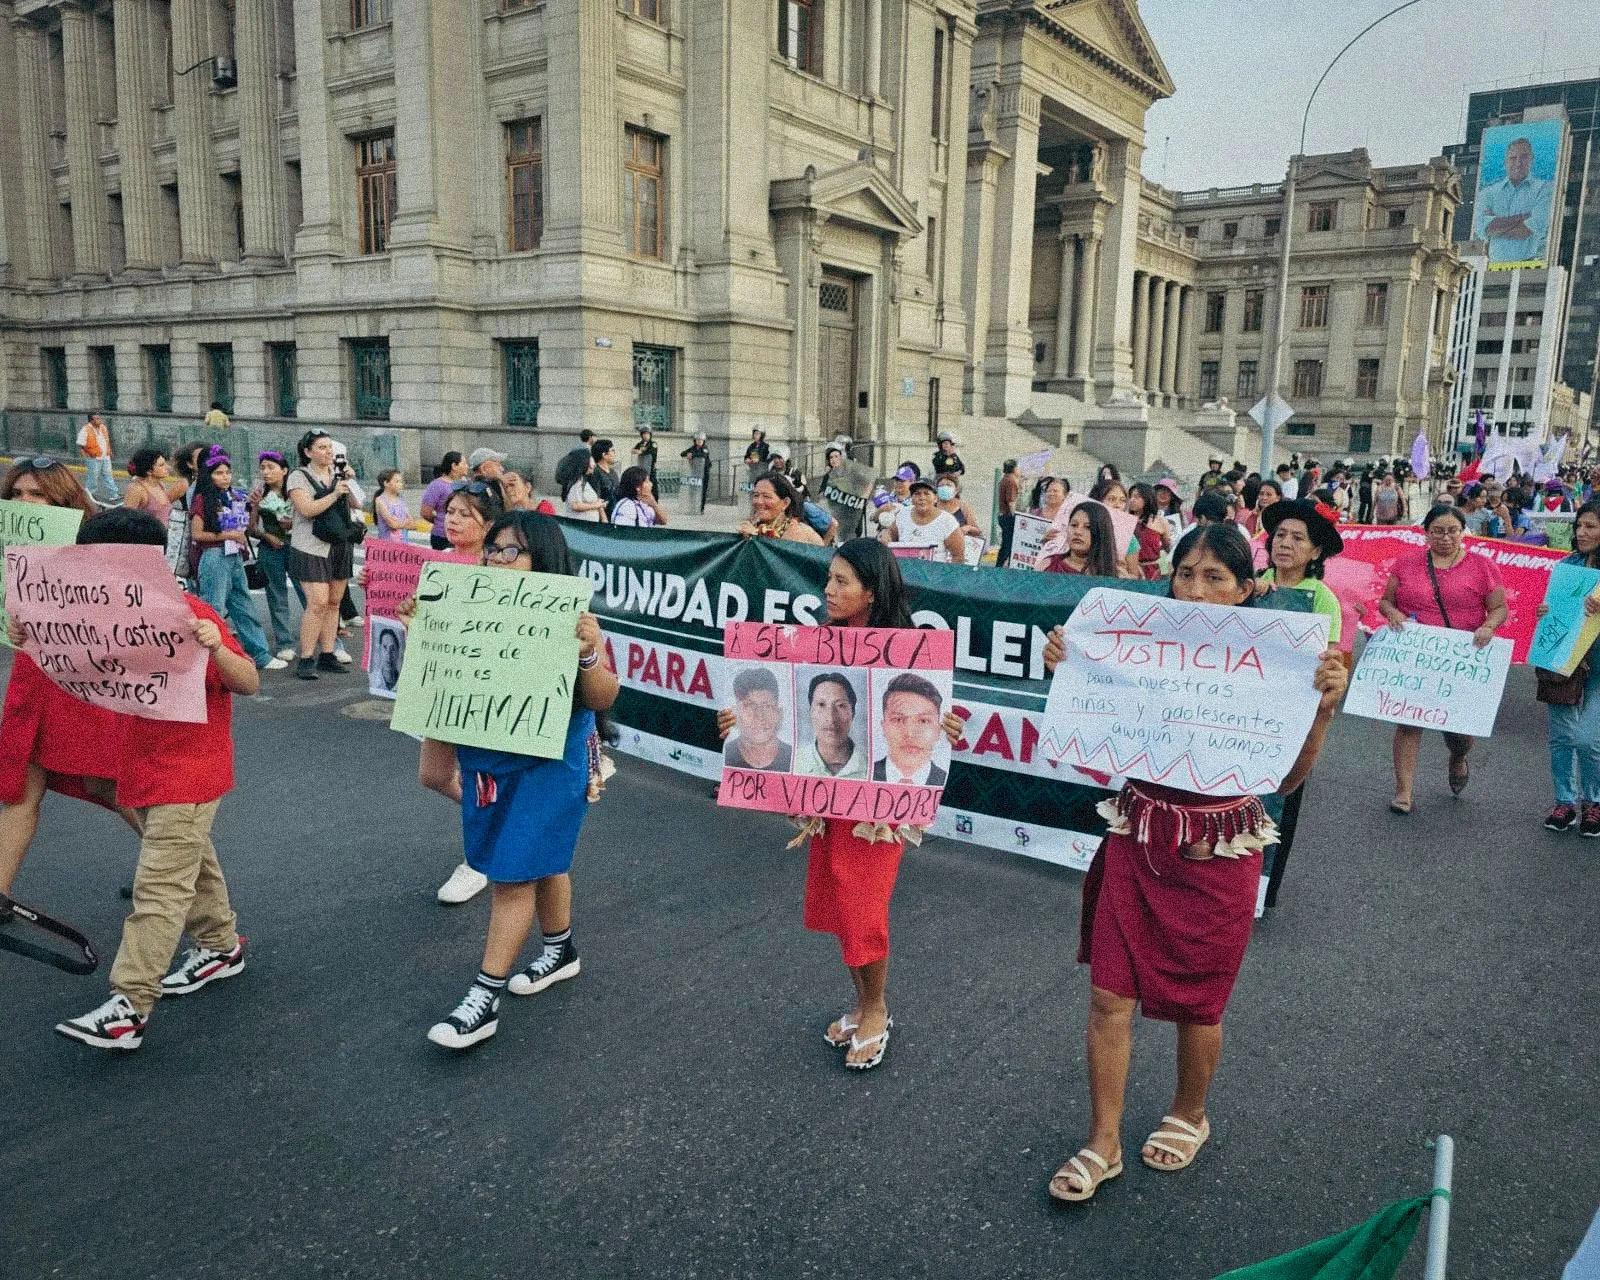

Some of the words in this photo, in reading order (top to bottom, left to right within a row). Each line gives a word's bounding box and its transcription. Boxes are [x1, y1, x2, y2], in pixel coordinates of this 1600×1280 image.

[824, 486, 865, 510] POLICIA
[125, 583, 143, 607] su
[461, 573, 588, 613] Balcázar
[423, 608, 452, 633] tener
[460, 616, 504, 634] sexo
[517, 625, 550, 640] con
[763, 590, 822, 628] ES
[812, 625, 933, 669] BUSCA
[1538, 615, 1570, 649] #8M
[87, 649, 126, 676] los
[420, 640, 482, 659] menores
[499, 642, 521, 660] de
[1362, 647, 1411, 663] primer
[420, 660, 437, 688] 14
[444, 668, 463, 680] no
[473, 668, 491, 680] es
[627, 641, 714, 700] PARA
[1357, 667, 1428, 691] erradicar
[1438, 677, 1452, 697] la
[1087, 673, 1114, 687] para
[1138, 675, 1234, 699] nuestras
[1071, 692, 1116, 713] niñas
[1137, 702, 1145, 722] y
[1161, 704, 1284, 735] adolescentes
[1187, 729, 1195, 746] y
[728, 771, 766, 801] POR
